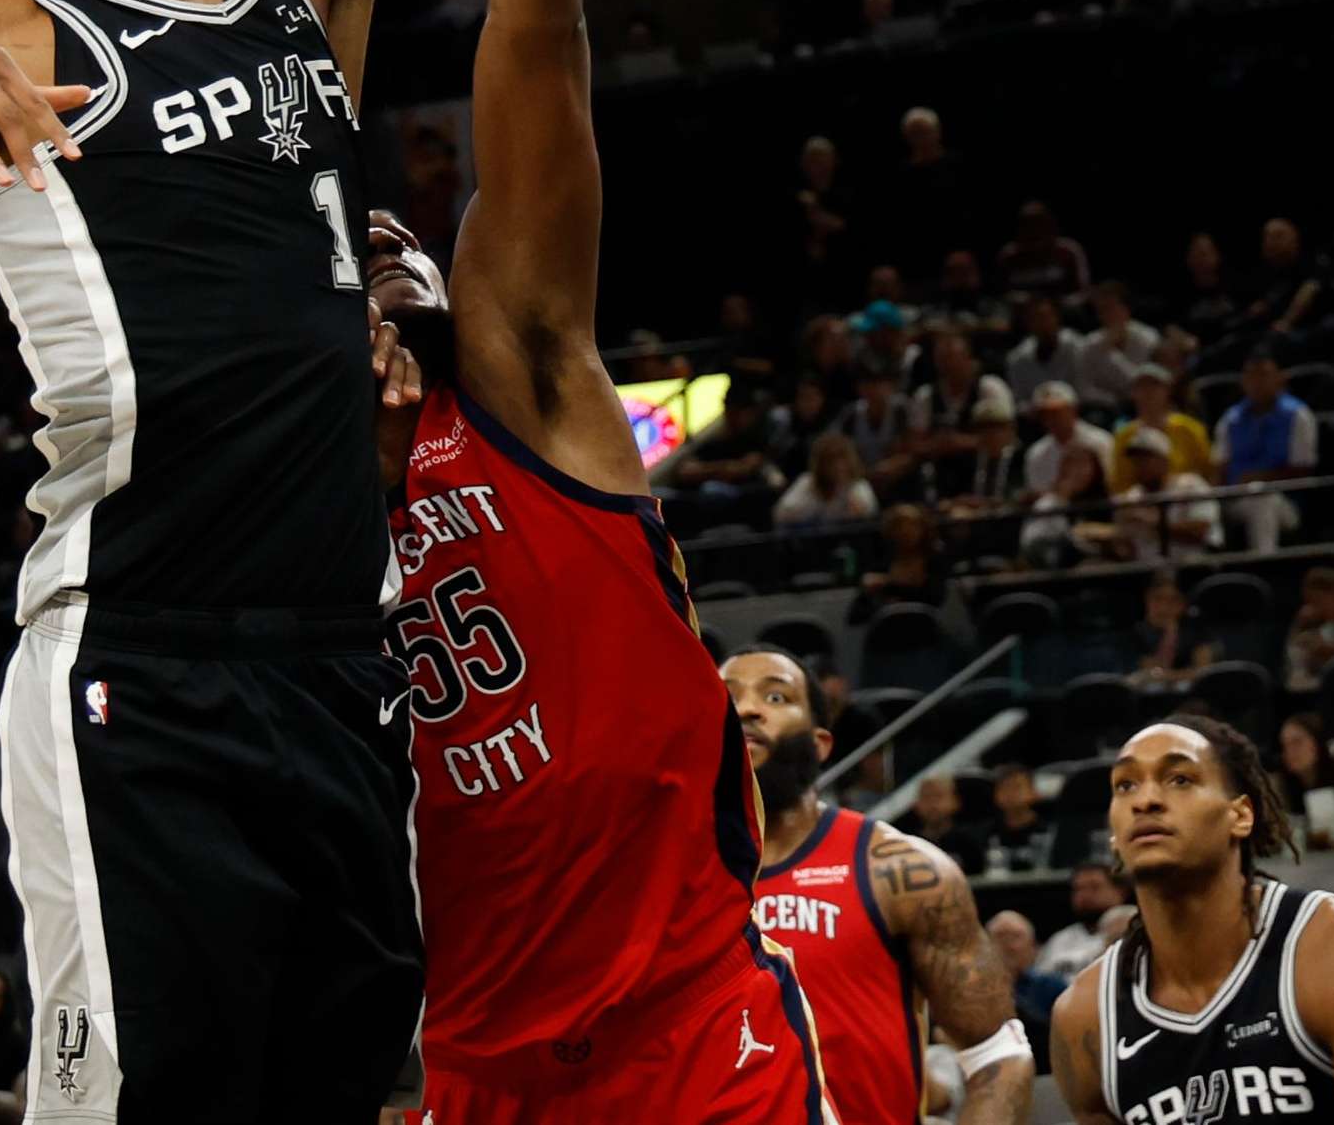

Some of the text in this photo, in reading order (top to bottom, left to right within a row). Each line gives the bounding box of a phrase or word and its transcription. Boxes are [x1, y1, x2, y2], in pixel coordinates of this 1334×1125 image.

[309, 168, 364, 291] 1
[383, 566, 527, 723] 55
[443, 702, 554, 796] CITY
